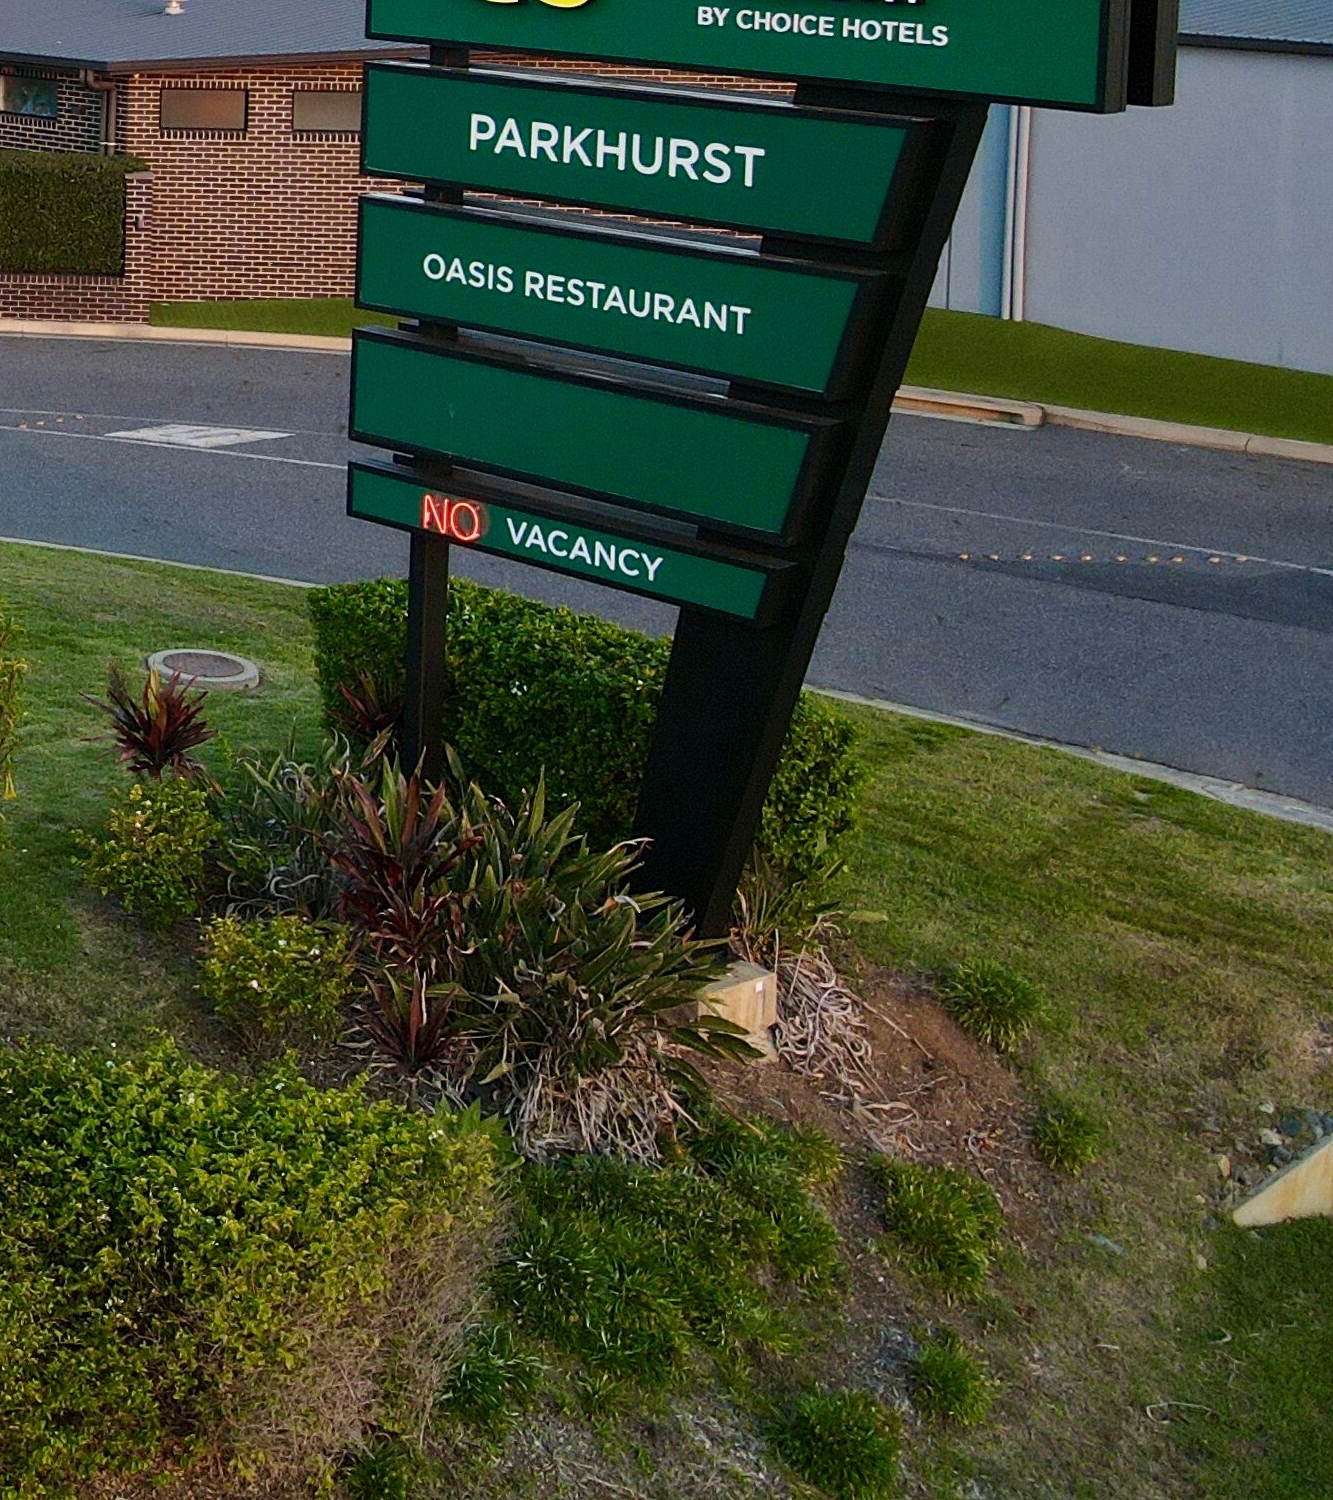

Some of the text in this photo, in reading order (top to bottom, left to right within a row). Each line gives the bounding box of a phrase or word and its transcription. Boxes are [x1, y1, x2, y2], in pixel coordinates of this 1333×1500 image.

[697, 5, 949, 47] BY CHOICE HOTELS
[469, 113, 766, 188] PARKHURST
[423, 253, 752, 335] OASIS RESTAURANT
[422, 493, 664, 582] NO VACANCY
